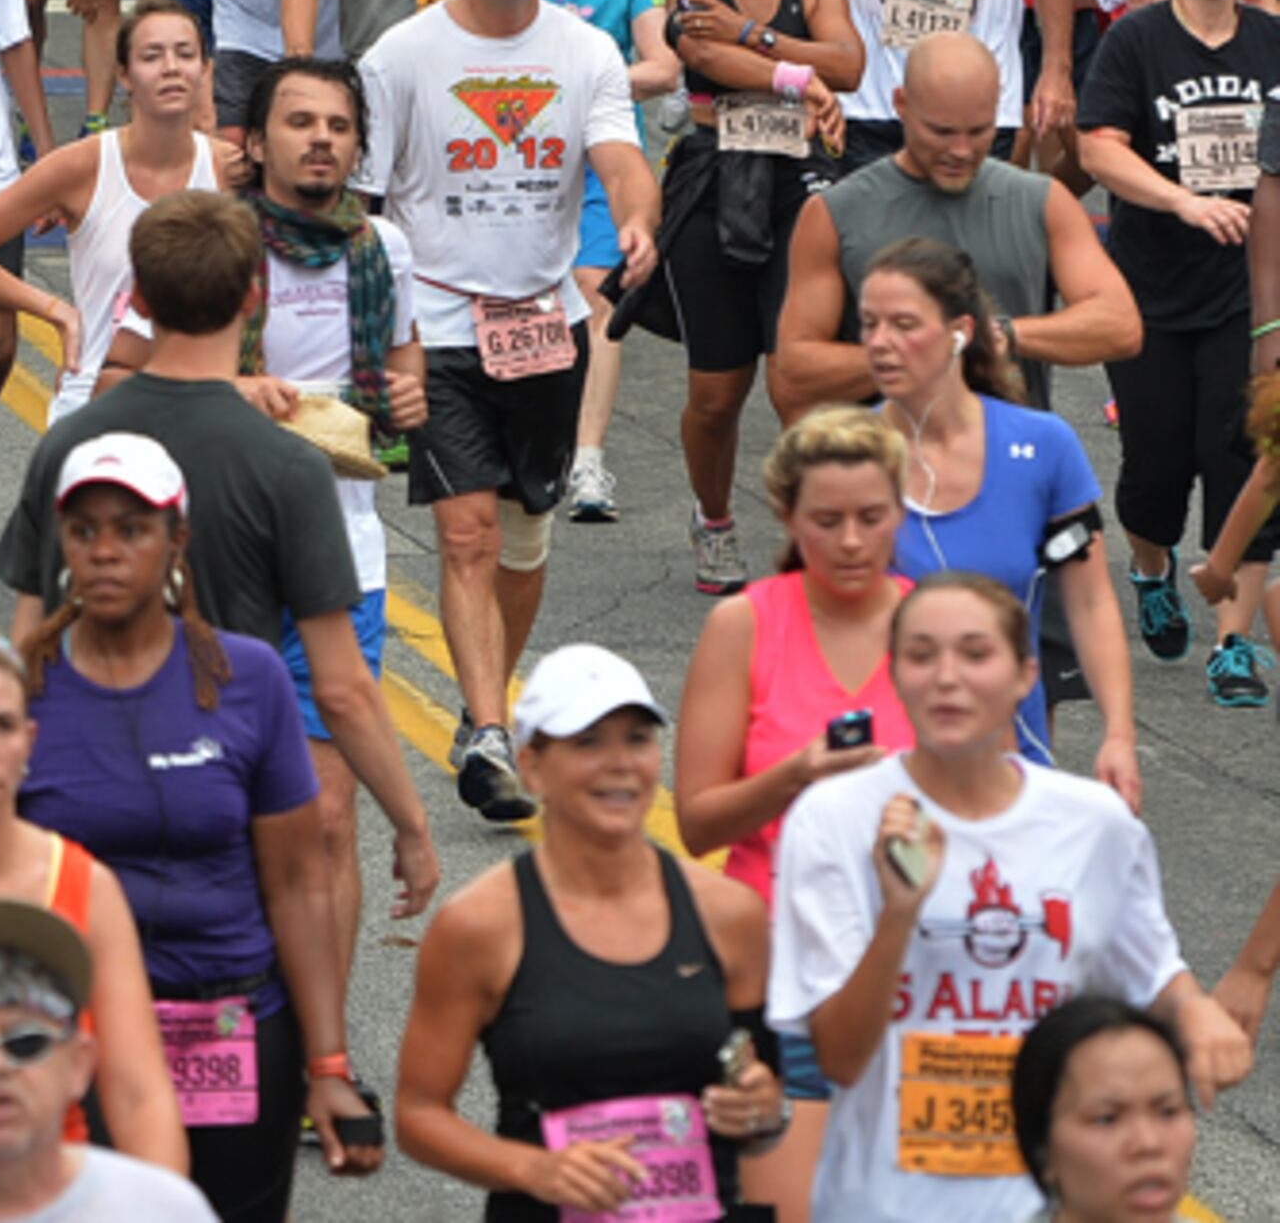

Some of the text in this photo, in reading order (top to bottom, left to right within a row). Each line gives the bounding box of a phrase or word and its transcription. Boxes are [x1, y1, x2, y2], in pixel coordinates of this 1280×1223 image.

[446, 138, 566, 171] 20 12
[1191, 144, 1201, 164] L
[487, 331, 502, 355] G
[928, 977, 1066, 1019] ALAR
[173, 1053, 241, 1087] 9398
[914, 1096, 1015, 1134] J 345
